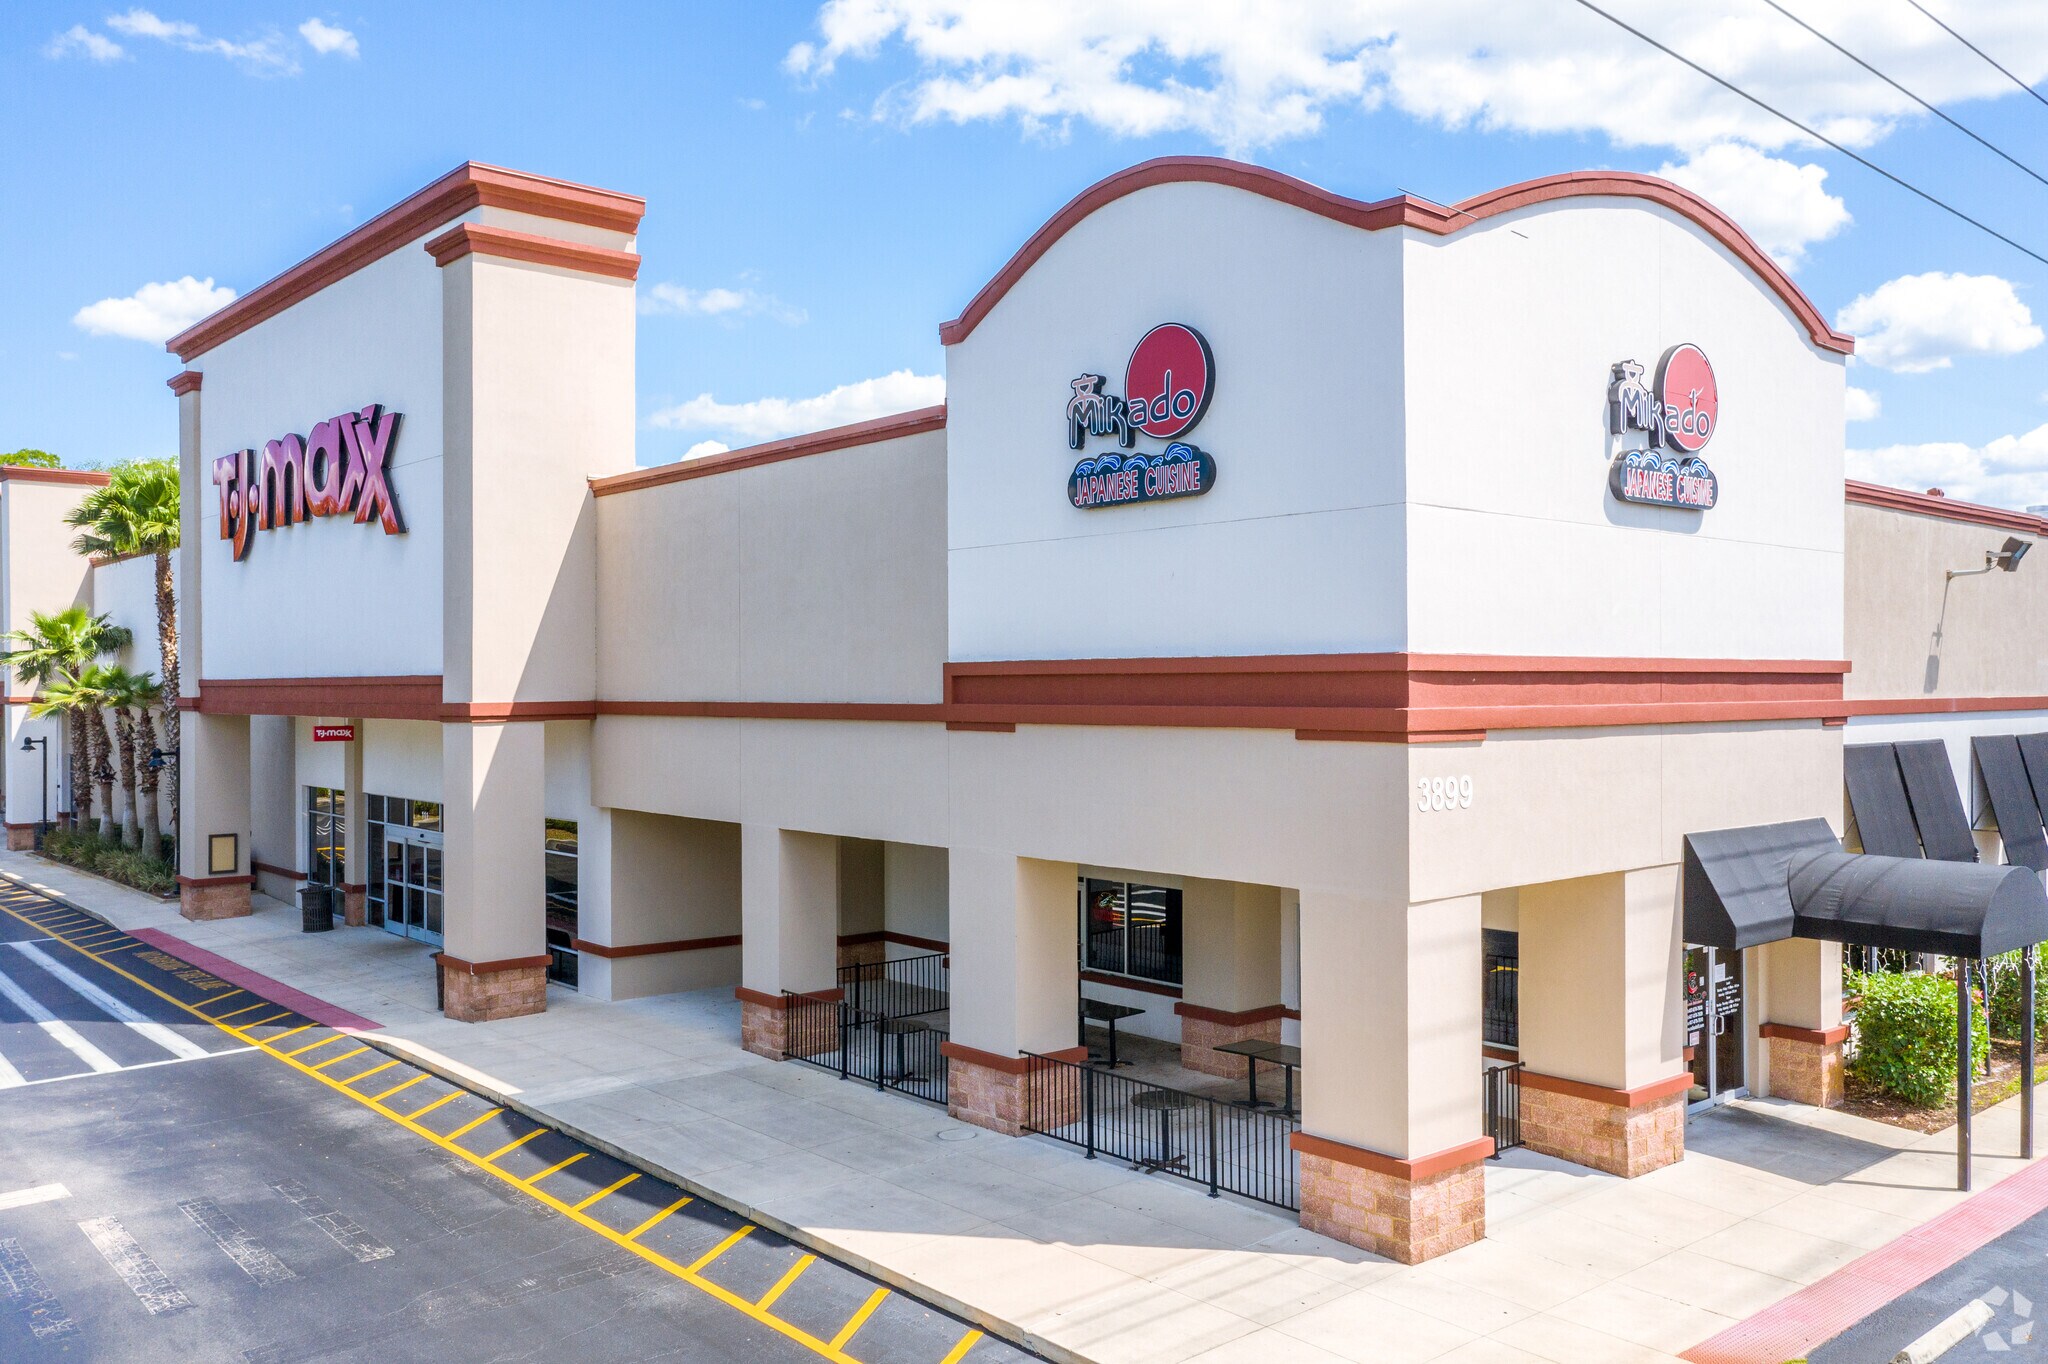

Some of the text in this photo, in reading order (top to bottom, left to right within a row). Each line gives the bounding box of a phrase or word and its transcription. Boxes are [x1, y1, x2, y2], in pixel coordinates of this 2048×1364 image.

[1069, 369, 1196, 449] Mikado
[1620, 388, 1710, 449] Mikado
[1074, 460, 1201, 506] JAPANESE CUISINE
[1624, 467, 1713, 507] JAPANESE CUISINE
[1417, 774, 1474, 813] 3899
